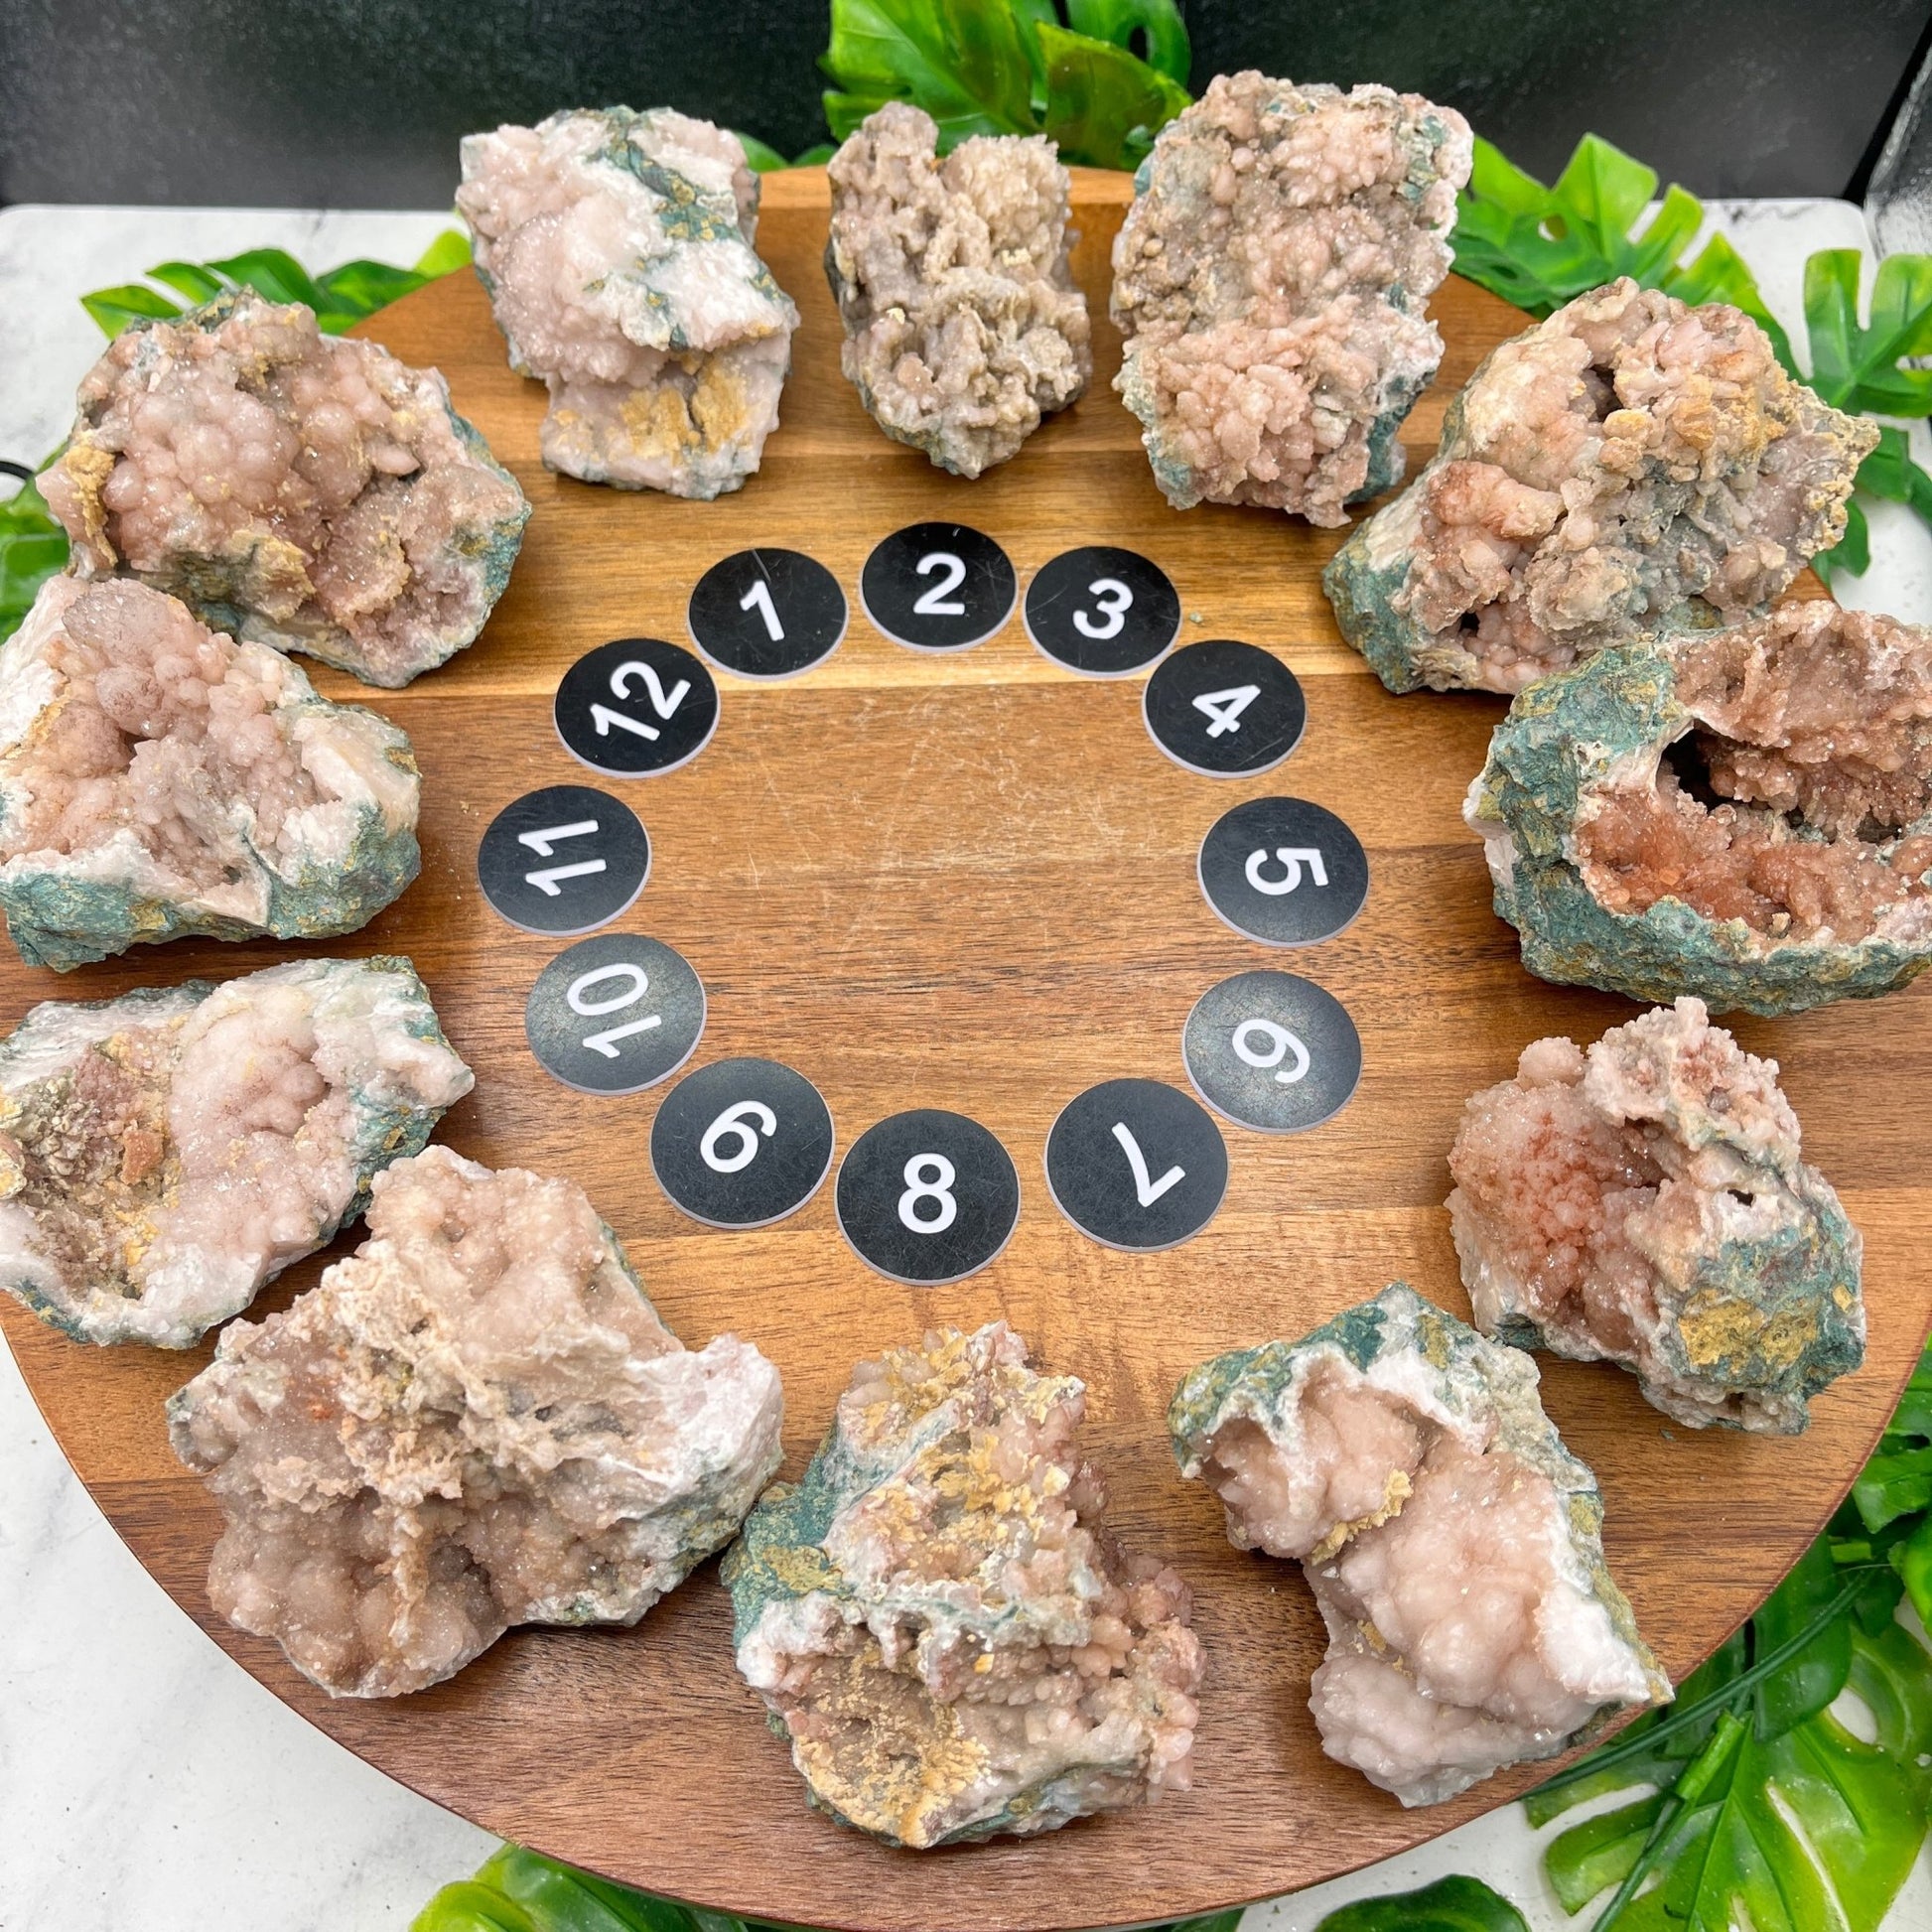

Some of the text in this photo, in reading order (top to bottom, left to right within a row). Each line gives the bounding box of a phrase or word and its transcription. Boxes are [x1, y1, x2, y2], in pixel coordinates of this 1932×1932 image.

[741, 581, 784, 640] 1
[914, 554, 965, 615] 2
[1074, 580, 1133, 638] 3
[591, 662, 690, 740] 12
[1192, 685, 1260, 737] 4
[519, 821, 606, 896] 11
[1246, 848, 1328, 895] 5
[562, 963, 662, 1058] 10
[898, 1154, 956, 1233] 8
[1112, 1123, 1185, 1207] 7
